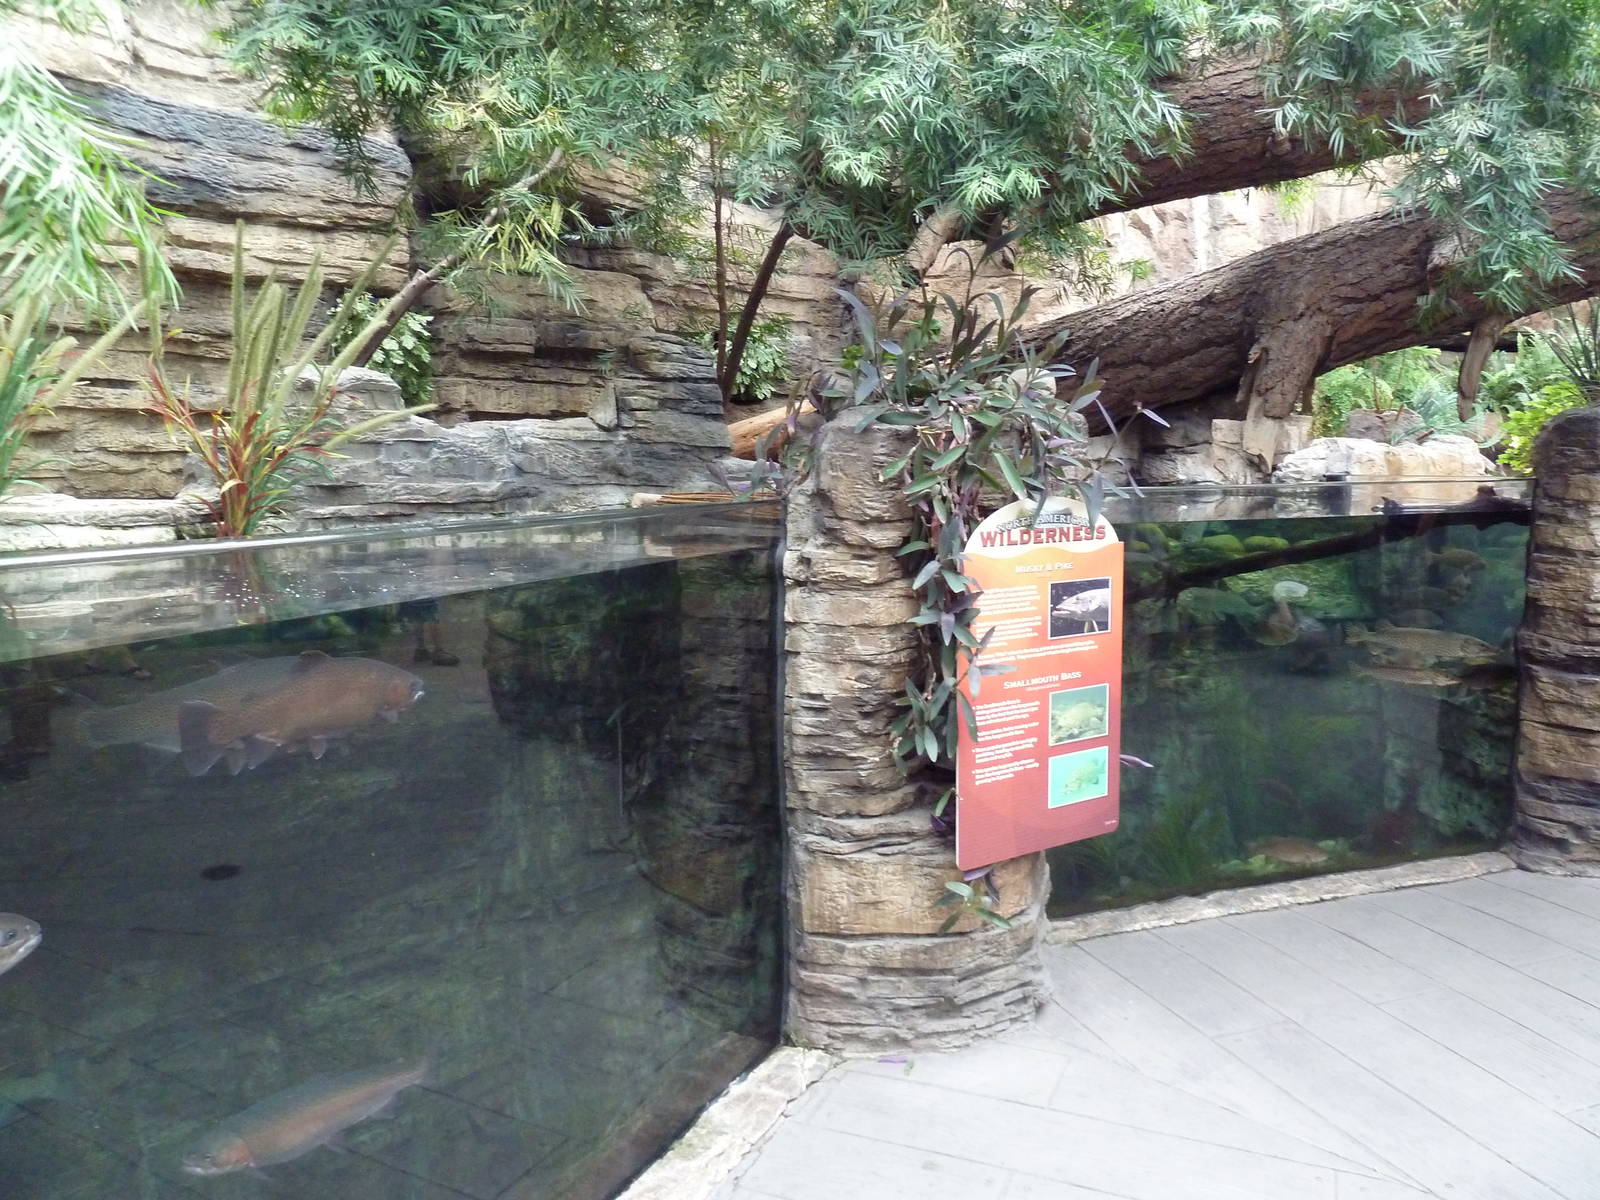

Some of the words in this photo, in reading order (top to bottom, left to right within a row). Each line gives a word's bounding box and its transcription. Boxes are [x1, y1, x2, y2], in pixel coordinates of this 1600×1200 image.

[980, 525, 1106, 548] WILDERNESS
[1003, 674, 1059, 689] SMALLMOUTH
[1060, 671, 1082, 682] BASS
